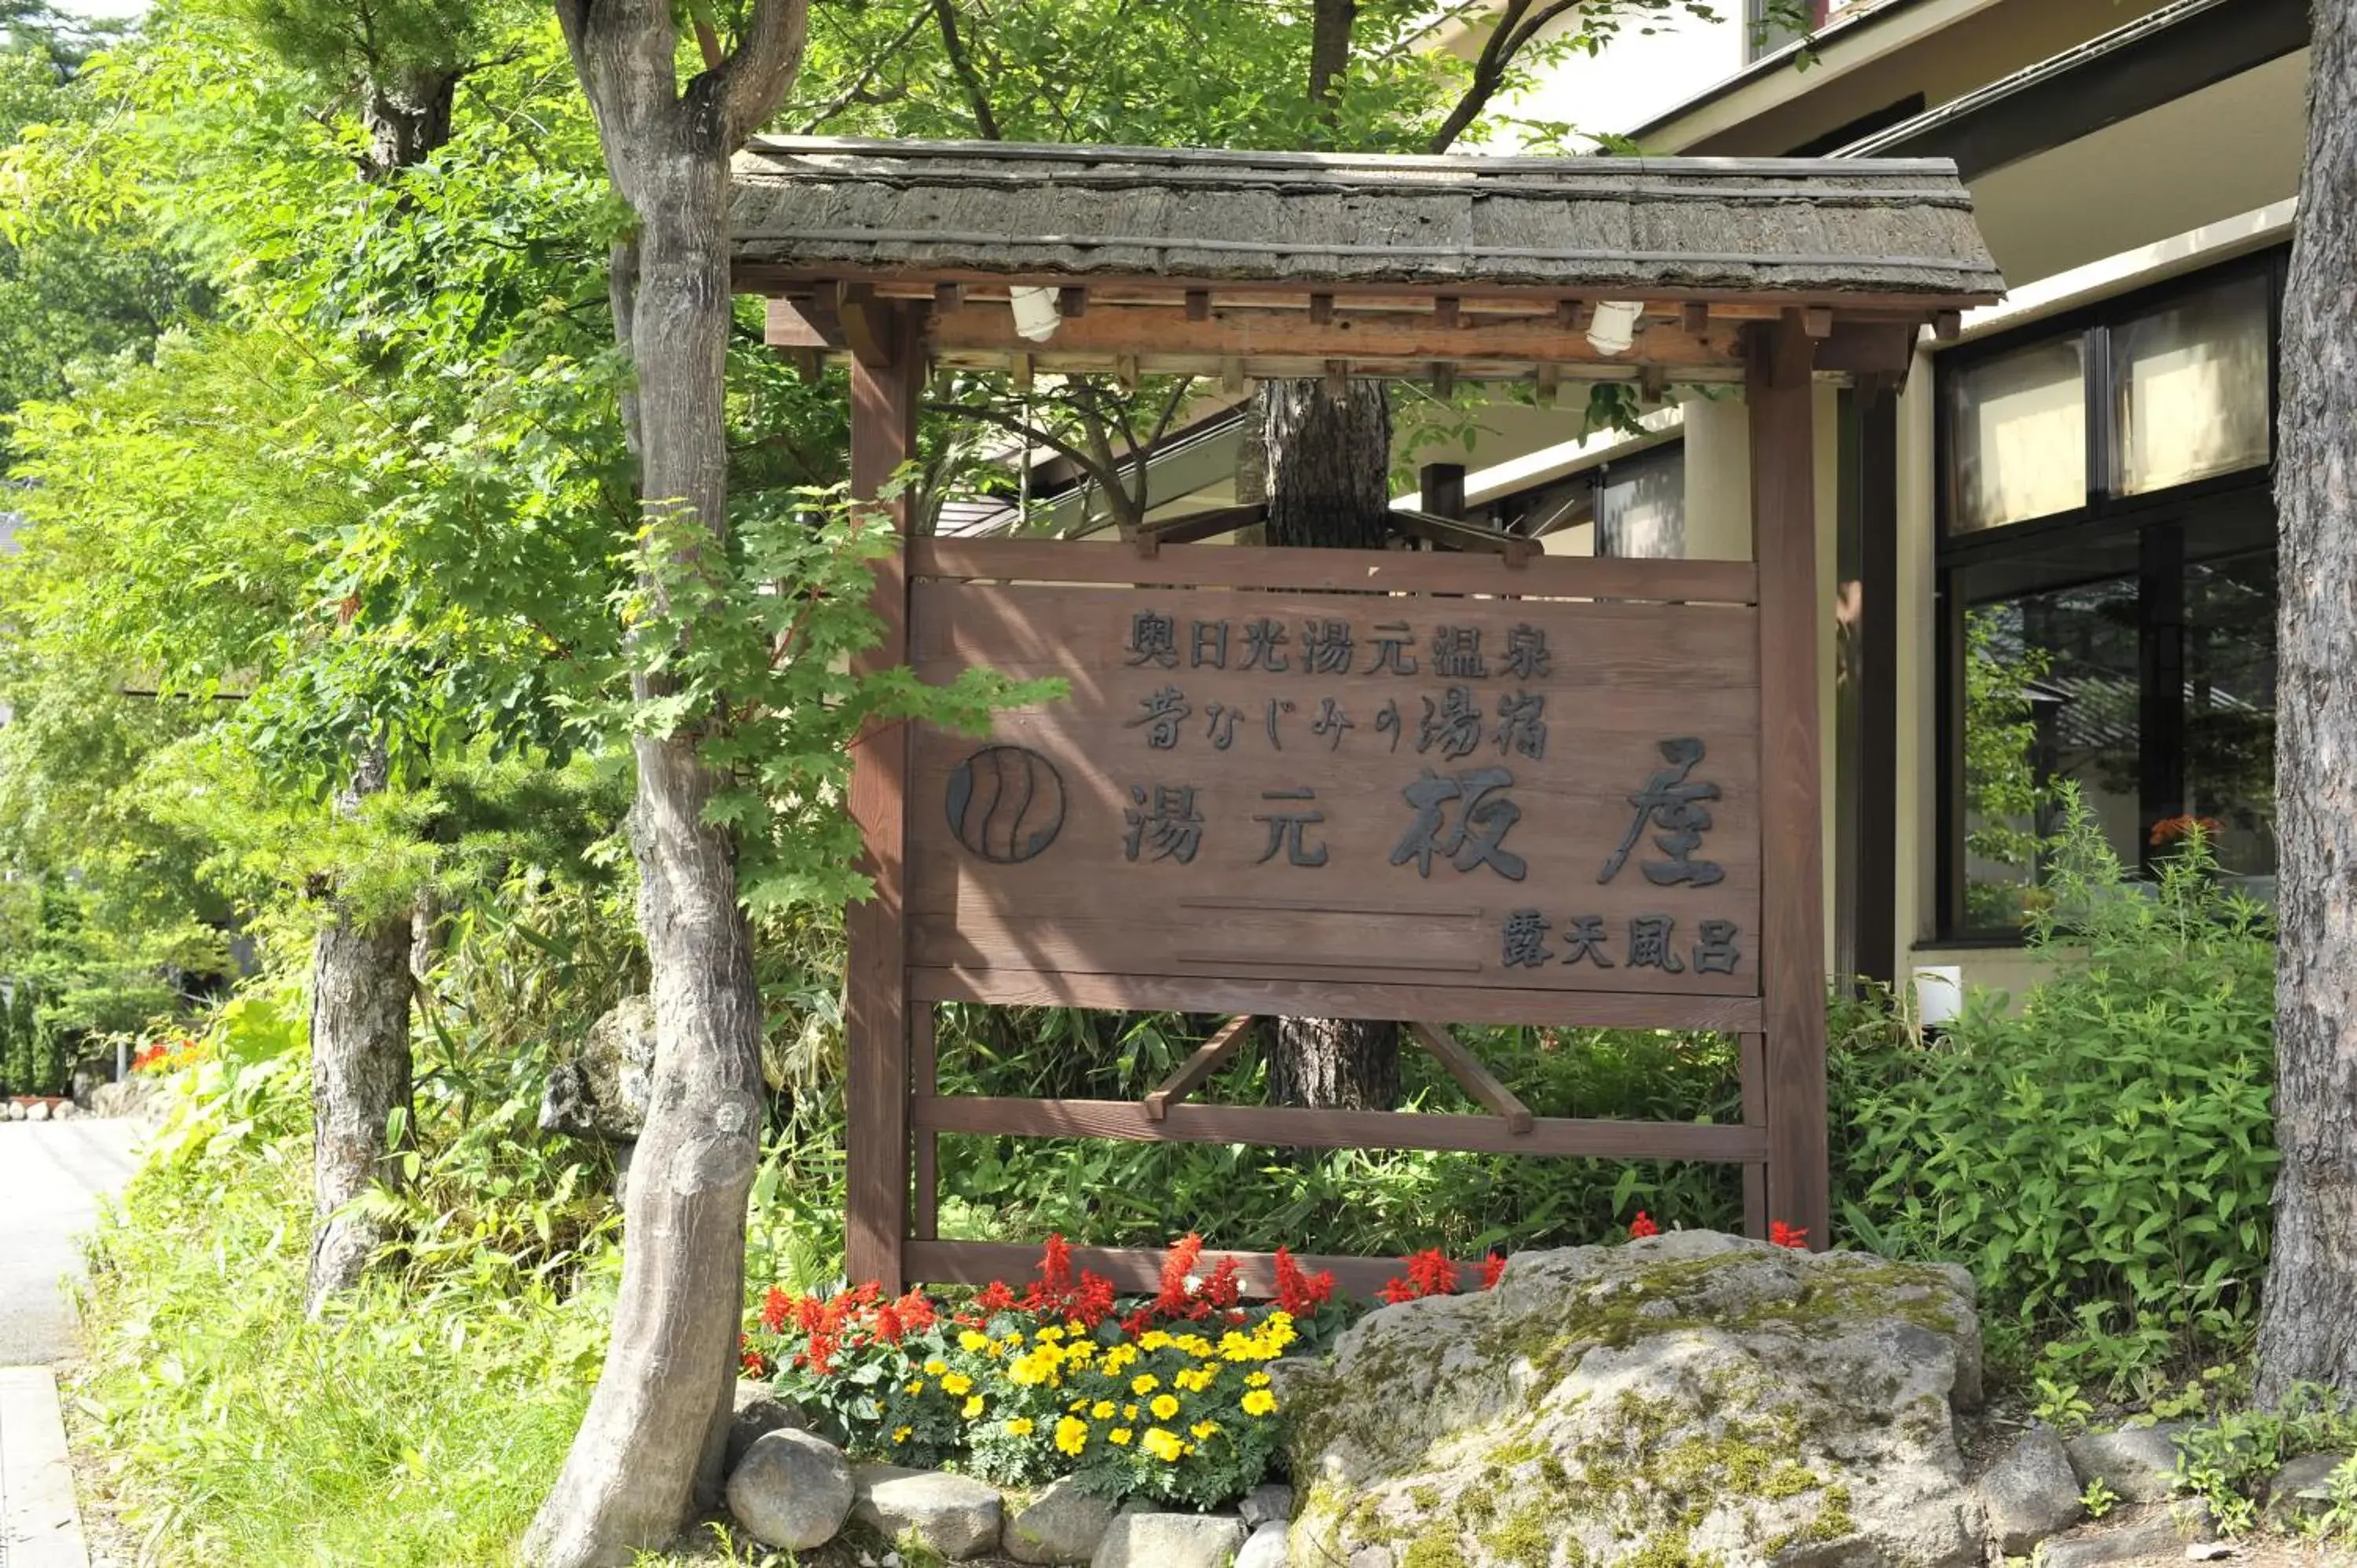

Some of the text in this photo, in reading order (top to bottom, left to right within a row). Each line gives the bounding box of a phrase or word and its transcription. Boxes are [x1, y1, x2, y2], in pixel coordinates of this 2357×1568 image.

[1124, 609, 1553, 680] 奥日光湯元温泉
[1124, 684, 1548, 761] 昔なじみの湯宿
[1502, 908, 1741, 976] 露天風呂
